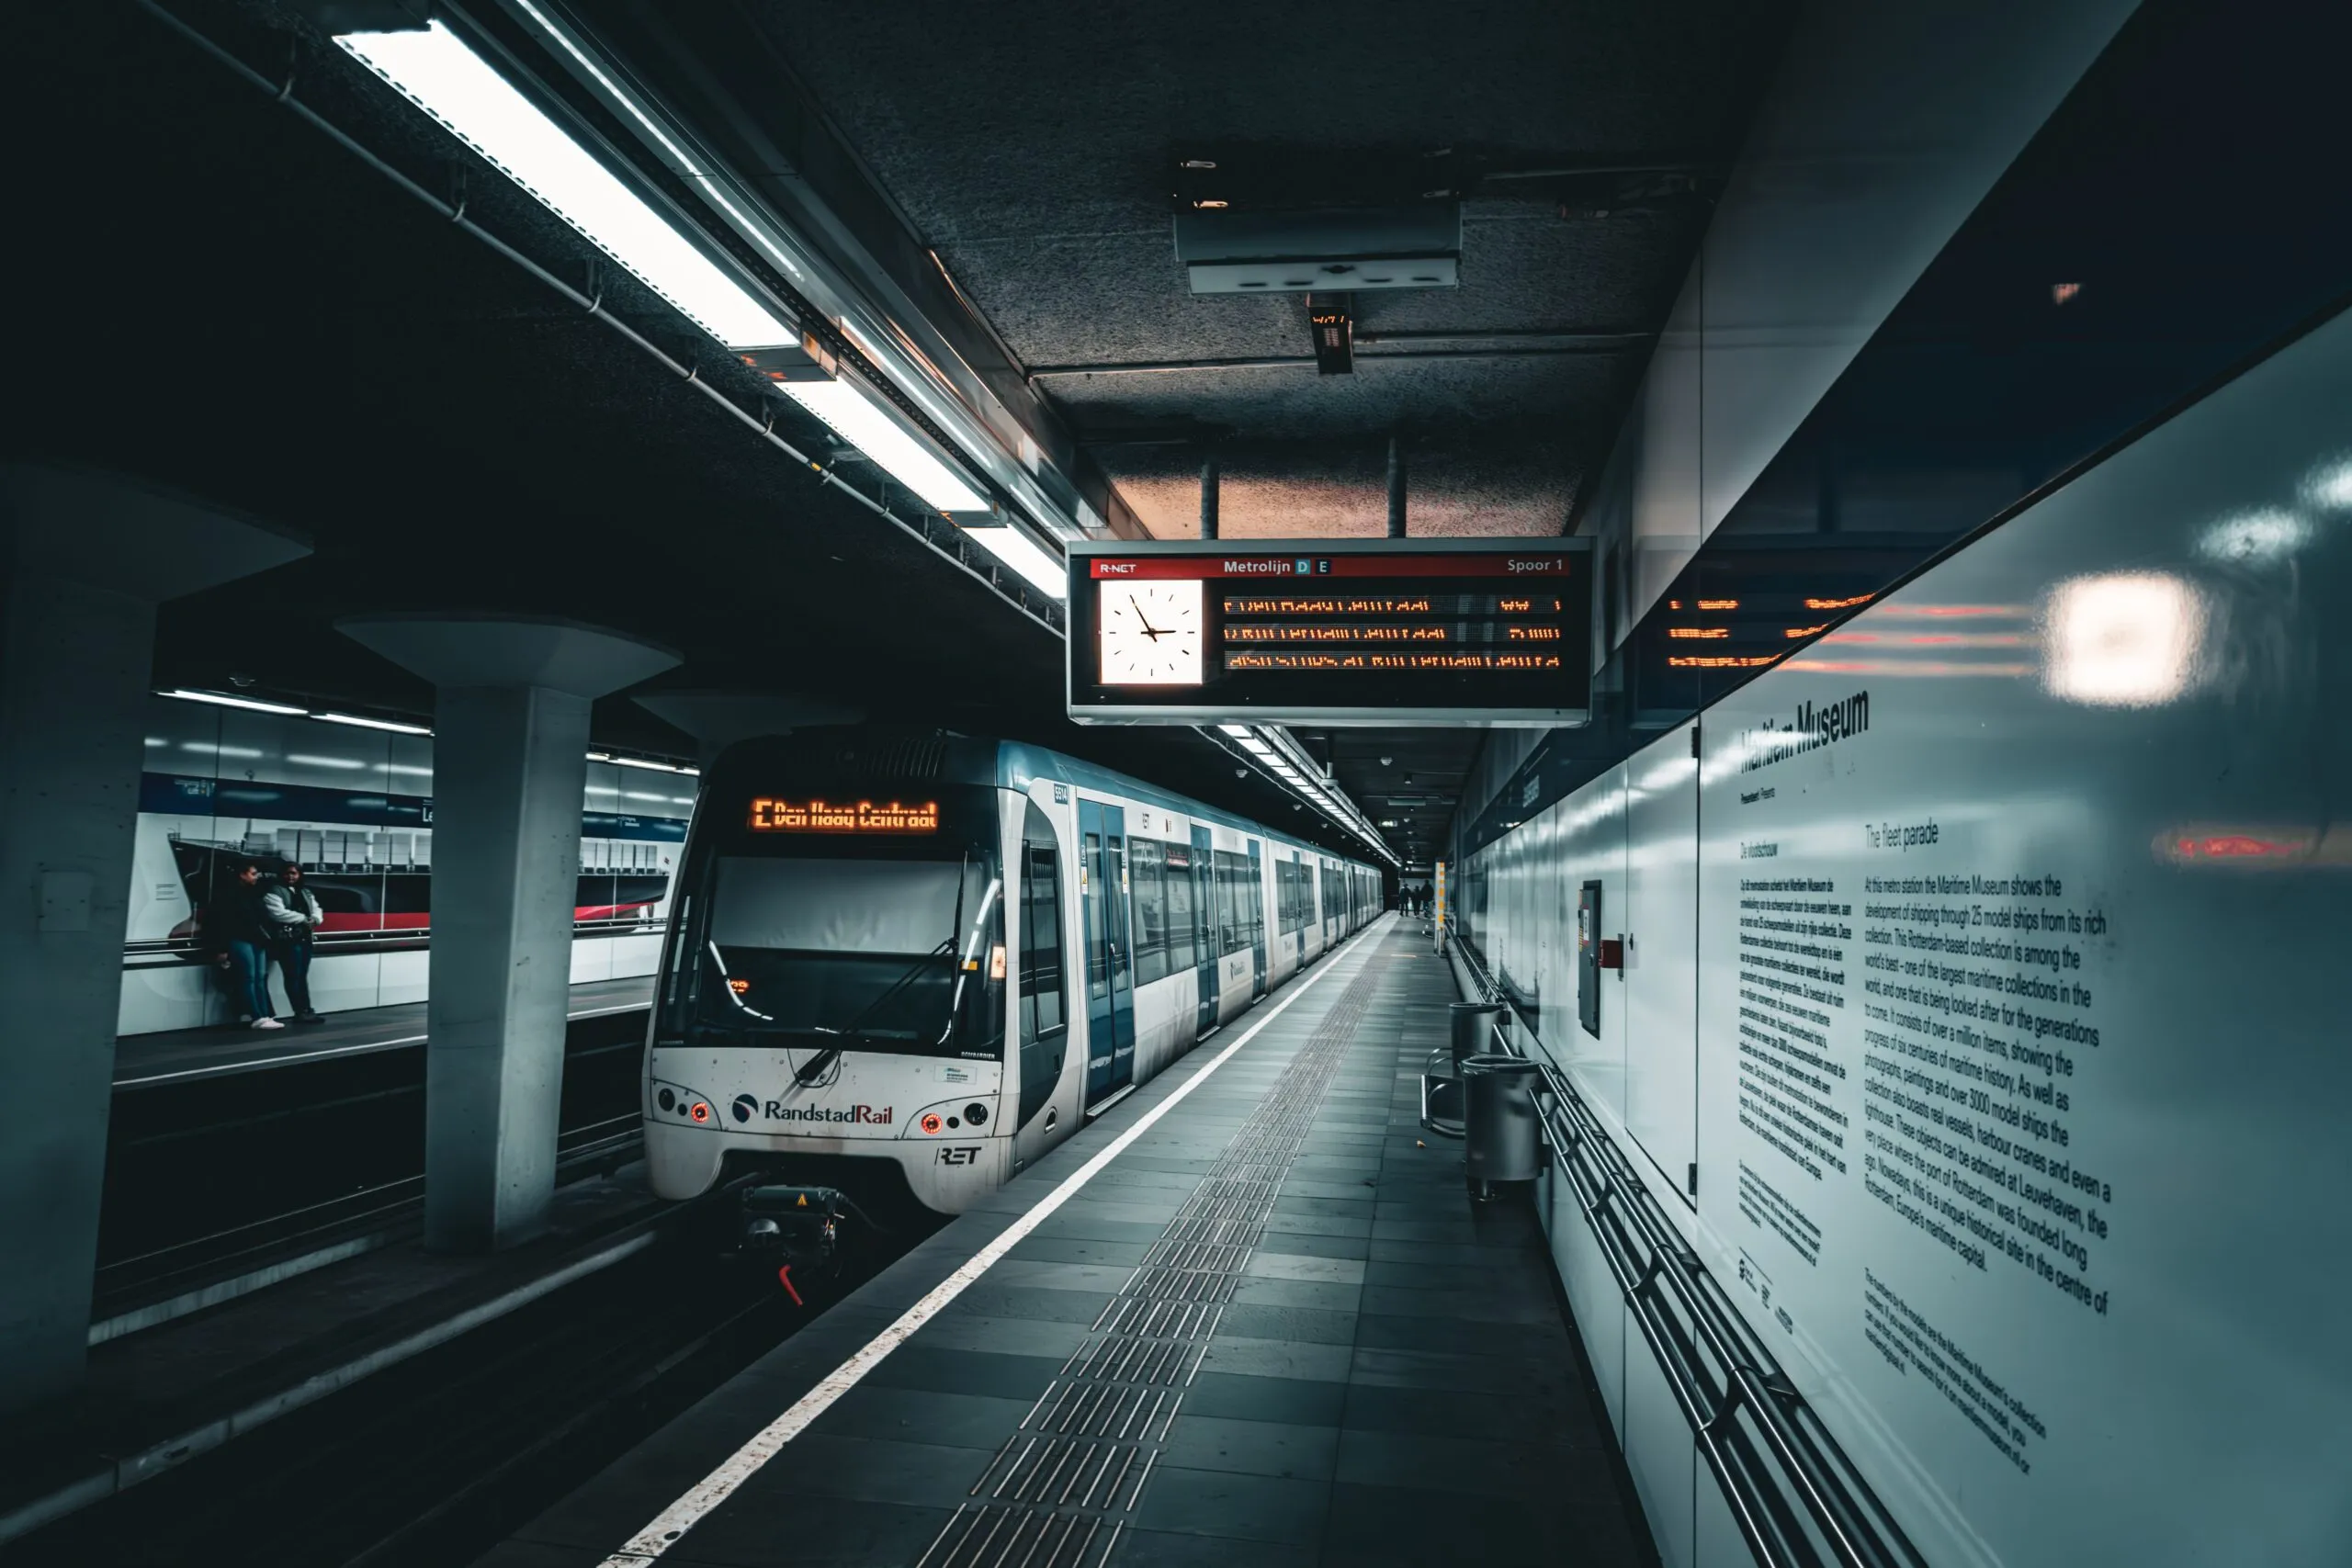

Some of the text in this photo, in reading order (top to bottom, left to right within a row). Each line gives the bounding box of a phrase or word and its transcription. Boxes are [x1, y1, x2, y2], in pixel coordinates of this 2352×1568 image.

[1099, 564, 1136, 573] R-NET
[1224, 560, 1328, 576] Metrolijn D E
[1508, 559, 1563, 573] Spoor 1
[1797, 690, 1869, 754] Museum
[1055, 786, 1069, 802] 5514
[1866, 817, 1939, 852] The fleet parade
[1925, 874, 1936, 895] the
[1937, 874, 1971, 896] Maritime
[1972, 874, 2008, 896] Museum
[2011, 874, 2041, 897] shows
[2044, 873, 2061, 897] the
[1940, 903, 1970, 931] through
[1972, 905, 1982, 927] 25
[1984, 906, 2011, 929] model
[2013, 907, 2039, 936] ships
[2041, 908, 2064, 933] from
[2068, 908, 2081, 934] its
[2085, 909, 2107, 936] rich
[1971, 936, 2012, 962] collection
[2014, 940, 2022, 963] is
[2024, 946, 2059, 974] among
[2063, 944, 2080, 971] the
[1927, 959, 1939, 981] the
[1939, 961, 1965, 989] largest
[1967, 967, 2003, 993] maritime
[2005, 973, 2057, 1003] collections
[2060, 979, 2070, 1005] in
[2073, 981, 2091, 1010] the
[1922, 987, 1928, 1007] is
[1929, 987, 1950, 1018] being
[1951, 992, 1978, 1020] looked
[1980, 999, 1999, 1024] after
[2002, 1003, 2014, 1028] for
[2017, 1006, 2032, 1032] the
[2035, 1016, 2099, 1048] generations
[1923, 1016, 1930, 1036] of
[1932, 1022, 1947, 1041] over
[1950, 1027, 1954, 1043] a
[2011, 1039, 2053, 1078] showing
[2056, 1049, 2073, 1078] the
[1939, 1049, 1948, 1070] of
[1949, 1055, 1982, 1082] maritime
[2018, 1073, 2031, 1100] As
[2033, 1082, 2053, 1108] well
[2056, 1091, 2068, 1113] as
[764, 1100, 893, 1124] RandstadRail
[1935, 1078, 1949, 1100] and
[1951, 1086, 1967, 1108] over
[1970, 1088, 1990, 1117] 3000
[1992, 1101, 2020, 1129] model
[2022, 1110, 2049, 1145] ships
[2052, 1118, 2068, 1148] the
[939, 1146, 982, 1165] RET
[1930, 1106, 1944, 1127] real
[1977, 1122, 2010, 1158] harbour
[2013, 1143, 2046, 1175] cranes
[2049, 1157, 2070, 1186] and
[2072, 1168, 2099, 1199] even
[2103, 1182, 2111, 1204] a
[1943, 1141, 1957, 1163] can
[1958, 1144, 1969, 1169] be
[1971, 1152, 2006, 1189] admired
[2008, 1170, 2017, 1194] at
[2087, 1206, 2107, 1241] the
[1926, 1161, 1941, 1184] port
[1942, 1168, 1951, 1190] of
[1952, 1170, 1995, 1214] Rotterdam
[1996, 1200, 2015, 1226] was
[2017, 1205, 2060, 1252] founded
[2063, 1229, 2087, 1274] long
[1926, 1217, 1957, 1252] maritime
[1926, 1184, 1932, 1207] is
[1933, 1193, 1939, 1211] a
[1939, 1197, 1965, 1228] unique
[1966, 1208, 2005, 1253] historical
[2007, 1235, 2024, 1265] site
[2025, 1243, 2034, 1271] in
[2037, 1249, 2053, 1283] the
[2056, 1268, 2091, 1307] centre
[2095, 1289, 2108, 1317] of
